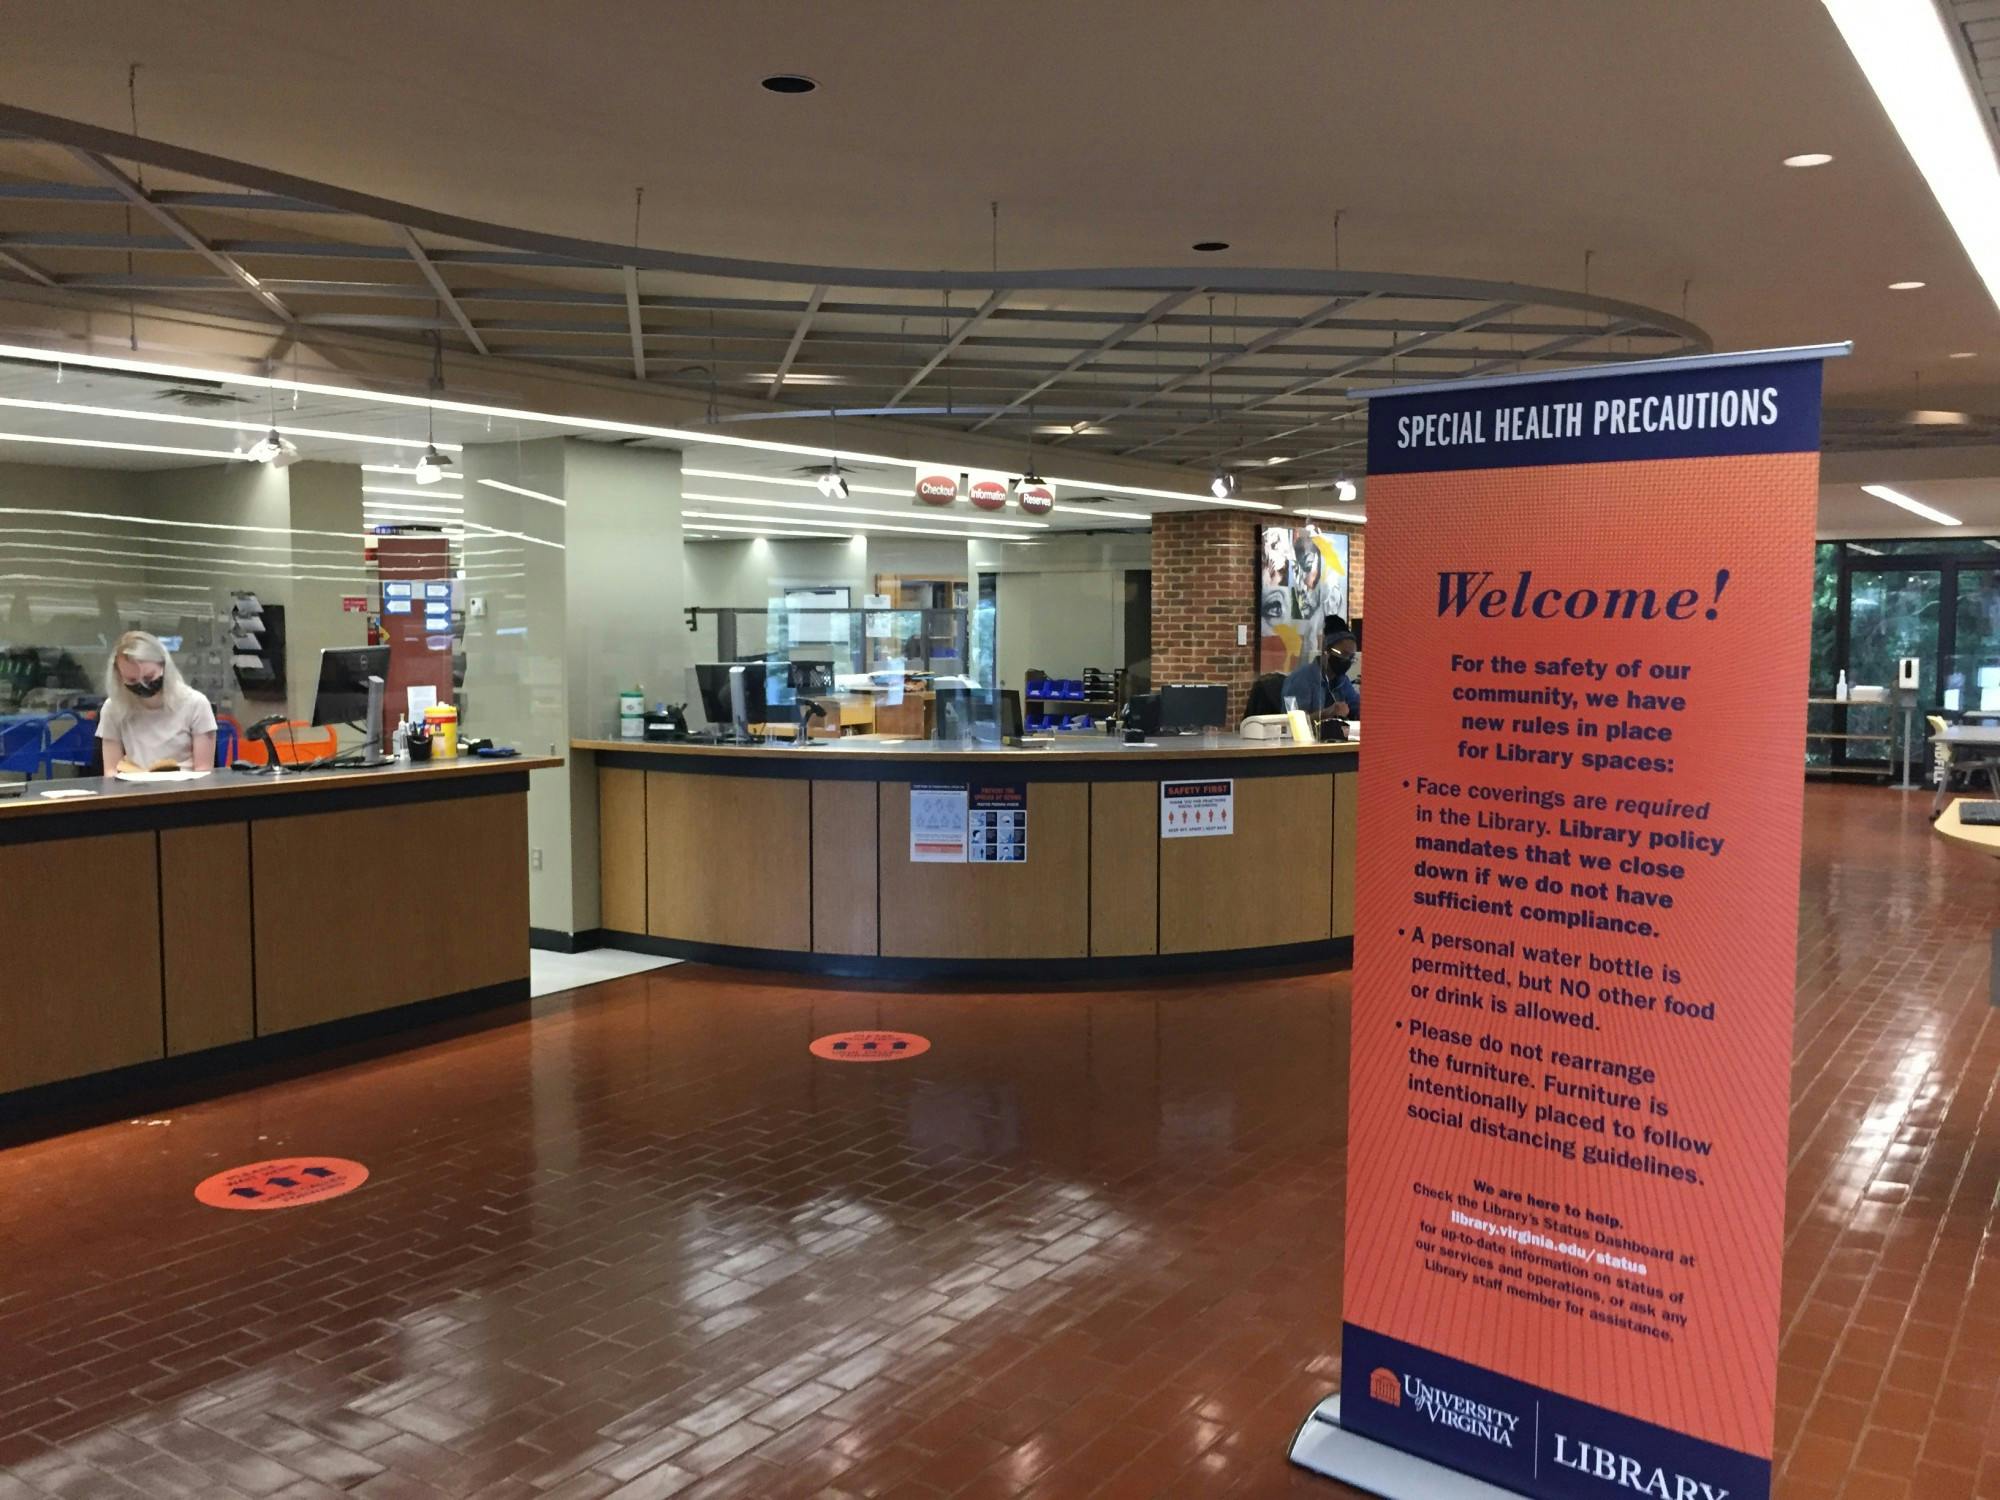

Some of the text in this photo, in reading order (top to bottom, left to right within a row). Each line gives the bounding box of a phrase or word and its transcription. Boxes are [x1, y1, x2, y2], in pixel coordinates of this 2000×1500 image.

[1398, 388, 1777, 448] SPECIAL HEALTH PRECAUTIONS
[922, 482, 954, 497] Checkout
[971, 488, 1006, 501] Information
[1023, 493, 1052, 507] Reserves
[1438, 569, 1730, 621] Welcome!
[1452, 655, 1691, 681] For the safety of our
[1453, 688, 1686, 711] community, we have
[1462, 717, 1672, 742] new rules in place
[1458, 740, 1673, 773] for Library spaces:
[1933, 742, 1945, 784] NDFILL
[1168, 786, 1200, 795] SAFETY
[1417, 777, 1710, 820] Face coverings are required
[1417, 805, 1724, 856] in the Library. Library policy
[1416, 837, 1685, 879] mandates that we close
[1415, 861, 1673, 909] down if we do not have
[1414, 891, 1659, 938] sufficient compliance.
[1412, 927, 1681, 984] A personal water bottle is
[1411, 985, 1600, 1030] or drink is allowed.
[1519, 971, 1552, 993] but
[1560, 978, 1590, 999] NO
[1598, 988, 1656, 1010] other
[1664, 995, 1714, 1020] food
[1410, 1019, 1655, 1085] Please do not rearrange
[1409, 1047, 1668, 1116] the furniture. Furniture is
[1408, 1076, 1712, 1156] intentionally placed to follow
[1408, 1105, 1705, 1186] social distancing guidelines.
[1413, 1183, 1695, 1267] Check the Library's Status Dashboard at
[1474, 1180, 1623, 1229] We are here to help.
[1420, 1220, 1684, 1304] for up-to-date information on status of
[1451, 1210, 1647, 1275] library.virginia.edu/status
[1416, 1240, 1434, 1252] our
[1440, 1246, 1494, 1270] services
[1499, 1265, 1522, 1278] and
[1610, 1296, 1624, 1308] or
[1630, 1302, 1655, 1317] ask
[1662, 1309, 1687, 1327] any
[1425, 1259, 1674, 1342] Library staff member for assistance.
[1403, 1374, 1519, 1432] UNIVERSITY
[1414, 1397, 1513, 1448] of VIRGINIA
